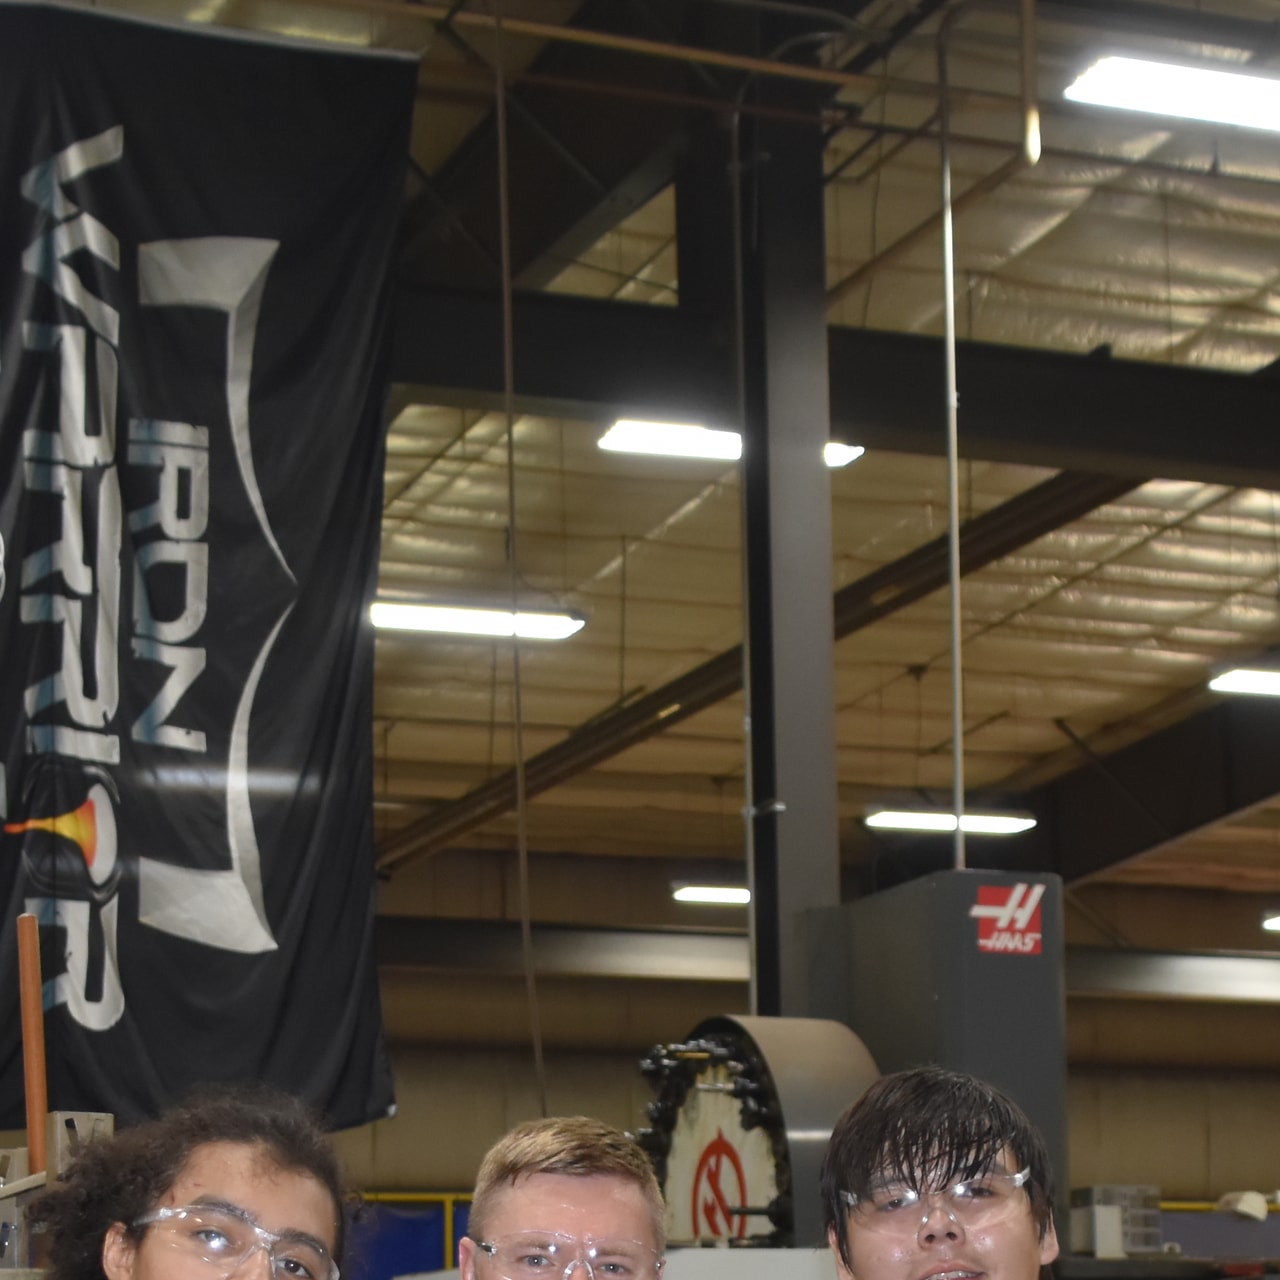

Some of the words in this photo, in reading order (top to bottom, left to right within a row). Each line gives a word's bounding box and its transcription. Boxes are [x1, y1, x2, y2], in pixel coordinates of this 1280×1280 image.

[19, 124, 125, 1032] WARRIOR
[128, 418, 210, 753] IRON
[978, 931, 1042, 953] HAAS
